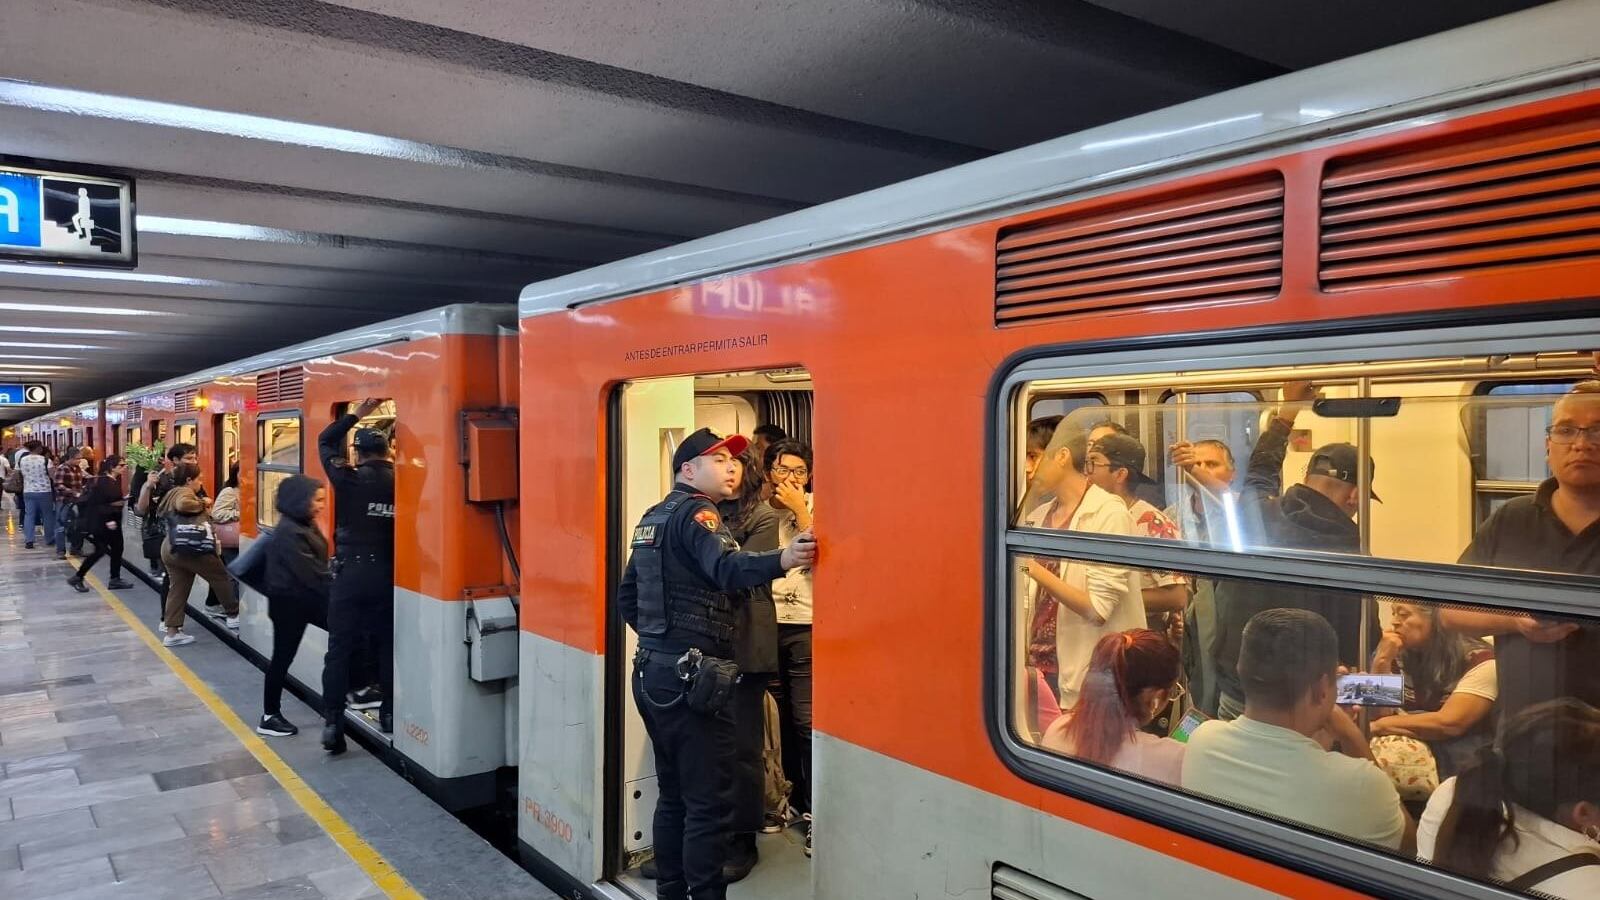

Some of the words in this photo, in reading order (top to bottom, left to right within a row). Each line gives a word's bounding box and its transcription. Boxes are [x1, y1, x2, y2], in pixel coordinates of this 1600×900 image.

[625, 350, 650, 361] ANTES
[650, 348, 661, 359] DE
[662, 343, 697, 358] ENTRAR
[697, 338, 738, 353] PERMITA
[739, 333, 768, 348] SALIR
[634, 526, 655, 540] POLICIA
